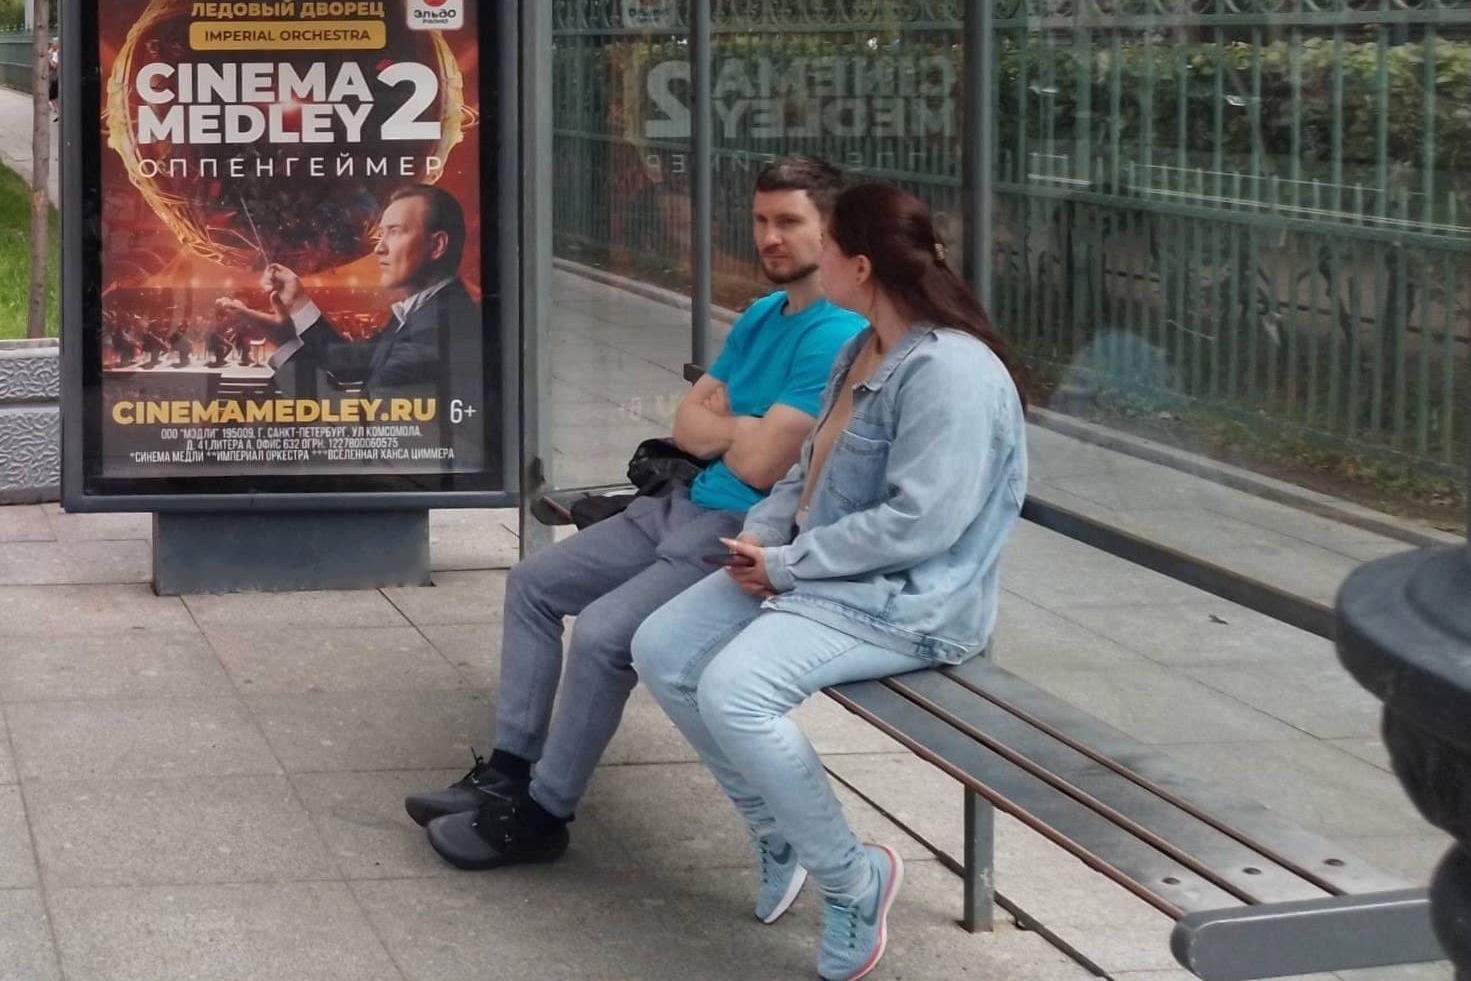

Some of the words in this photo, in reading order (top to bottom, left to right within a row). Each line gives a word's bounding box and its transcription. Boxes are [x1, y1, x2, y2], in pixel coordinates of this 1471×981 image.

[191, 0, 294, 18] ЛЕДОВЫЙ
[300, 1, 385, 18] ДВОРЕЦ
[205, 30, 276, 42] IMPERIAL
[280, 29, 370, 41] ORCHESTRA
[135, 62, 374, 104] CINEMA
[377, 61, 442, 141] 2
[138, 103, 374, 144] MEDLEY
[139, 152, 443, 178] ОППЕНГЕЙМЕР
[112, 398, 436, 425] CINEMAMEDLEY.RU
[450, 399, 477, 424] 6+
[161, 427, 178, 439] ООО
[256, 438, 281, 450] ОФИС
[283, 438, 299, 449] 632
[172, 450, 204, 463] МЕДЛИ
[266, 449, 309, 461] ОРКЕСТРА
[380, 448, 409, 460] ХАНСА
[411, 448, 454, 460] ЦИММЕРА
